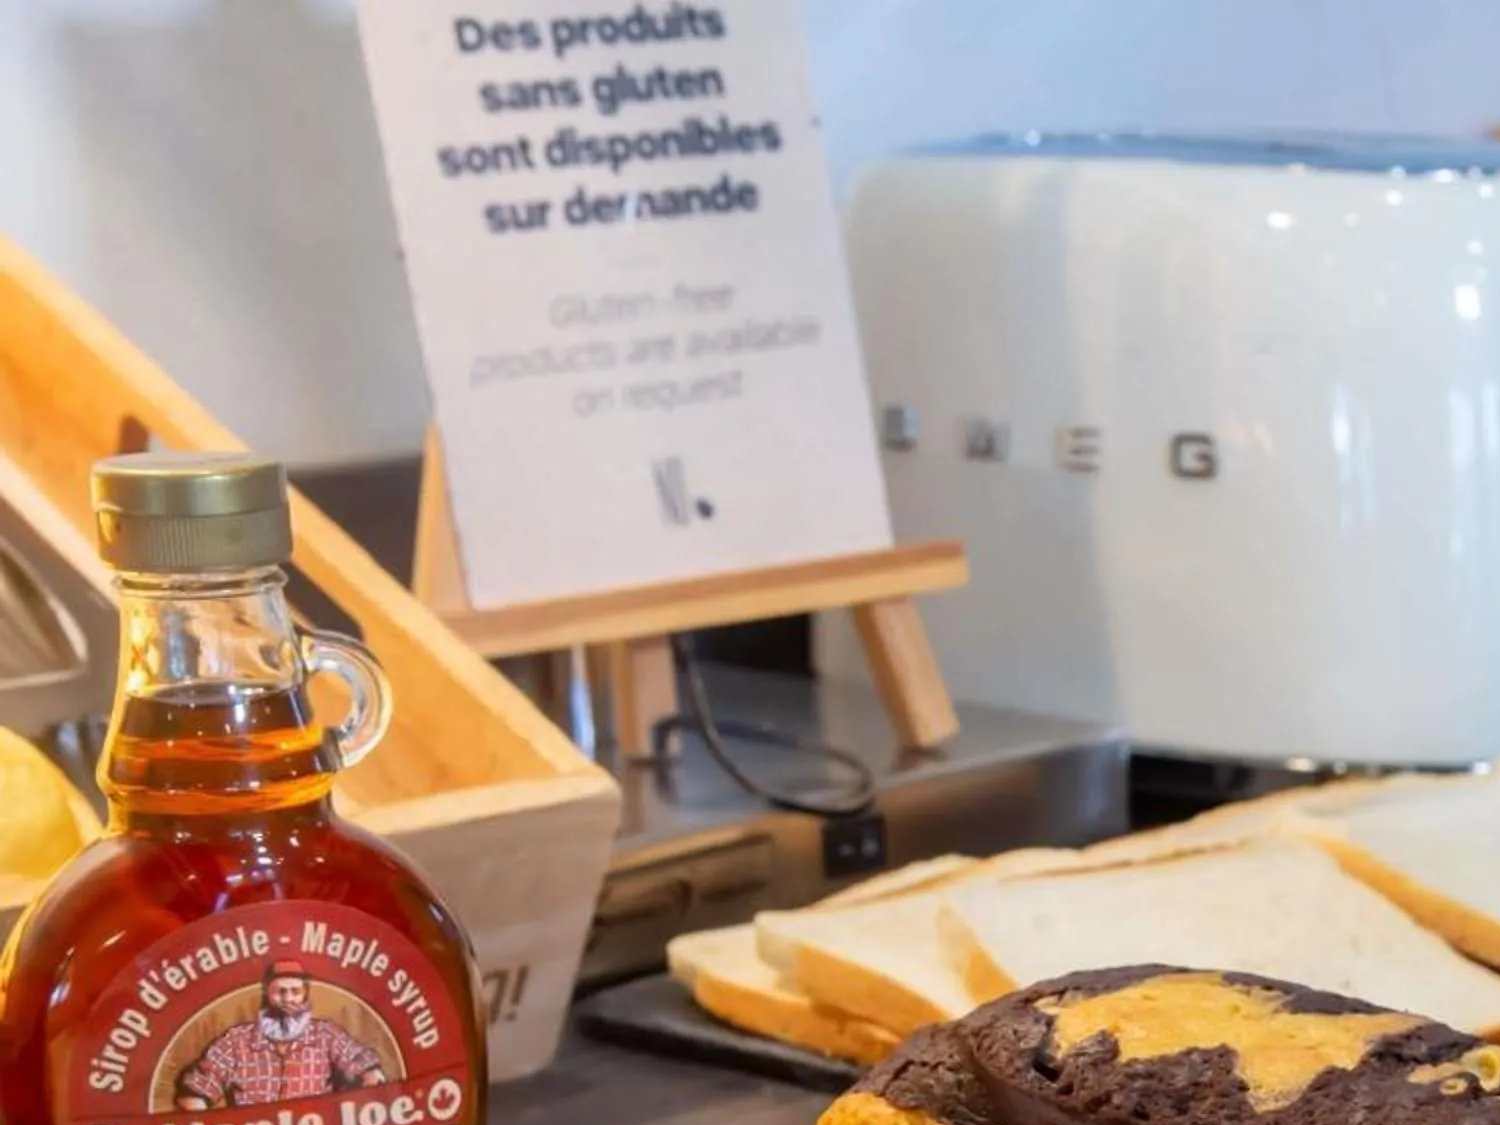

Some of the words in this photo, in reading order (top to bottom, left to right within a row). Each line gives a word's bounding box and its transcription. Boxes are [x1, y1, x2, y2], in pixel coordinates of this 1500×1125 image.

[454, 17, 541, 52] Des
[551, 2, 726, 57] produits
[480, 78, 582, 112] sans
[592, 61, 725, 116] gluten
[436, 135, 535, 177] sont
[545, 116, 782, 175] disponibles
[484, 199, 551, 233] sur
[89, 1008, 151, 1092] Sirop
[137, 926, 270, 1010] d'érable
[301, 921, 389, 977] Maple
[387, 969, 440, 1049] syrup
